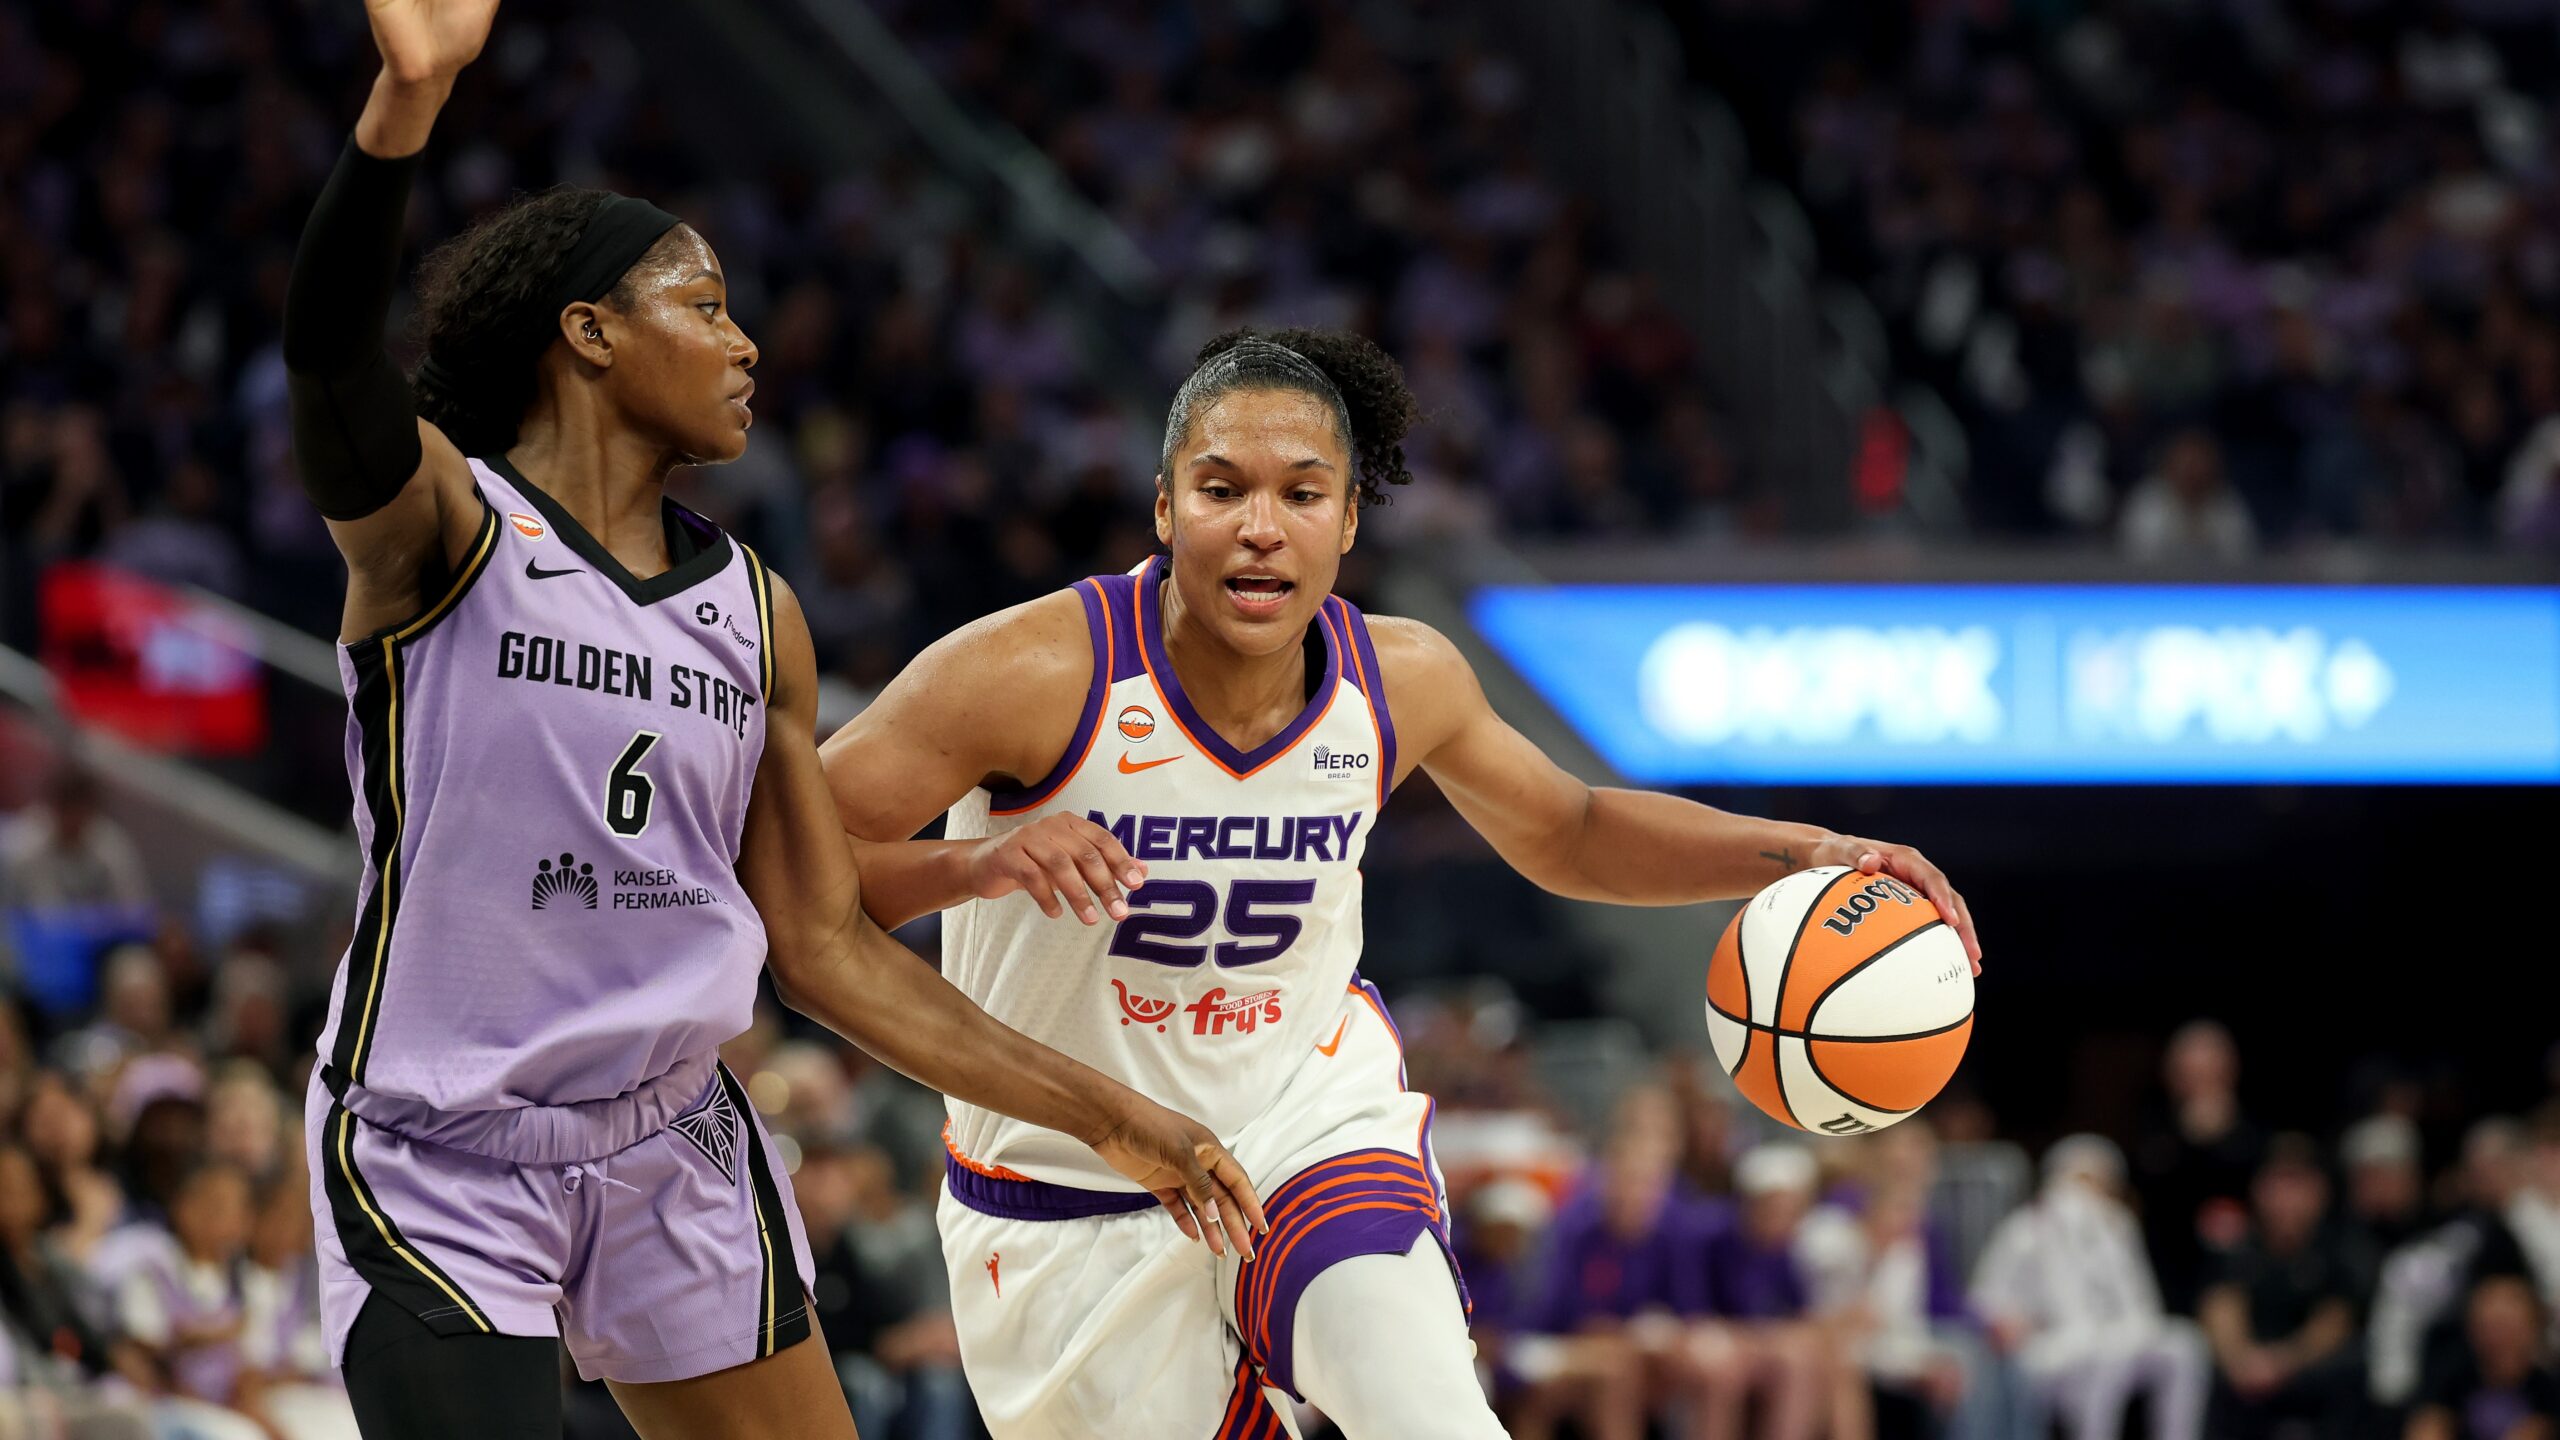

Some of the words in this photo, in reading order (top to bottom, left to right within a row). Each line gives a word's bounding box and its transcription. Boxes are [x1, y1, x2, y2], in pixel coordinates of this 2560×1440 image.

[498, 631, 652, 700] GOLDEN
[670, 664, 757, 741] STATE
[603, 729, 664, 839] 6
[1313, 750, 1369, 770] HERO
[1086, 810, 1362, 861] MERCURY
[613, 888, 728, 909] PERMANEN
[614, 869, 677, 886] KAISER
[1108, 878, 1317, 968] 25
[1821, 878, 1926, 937] ilson
[1184, 987, 1282, 1035] fry's
[1219, 1000, 1243, 1011] FOOD
[1244, 991, 1273, 1005] STORES
